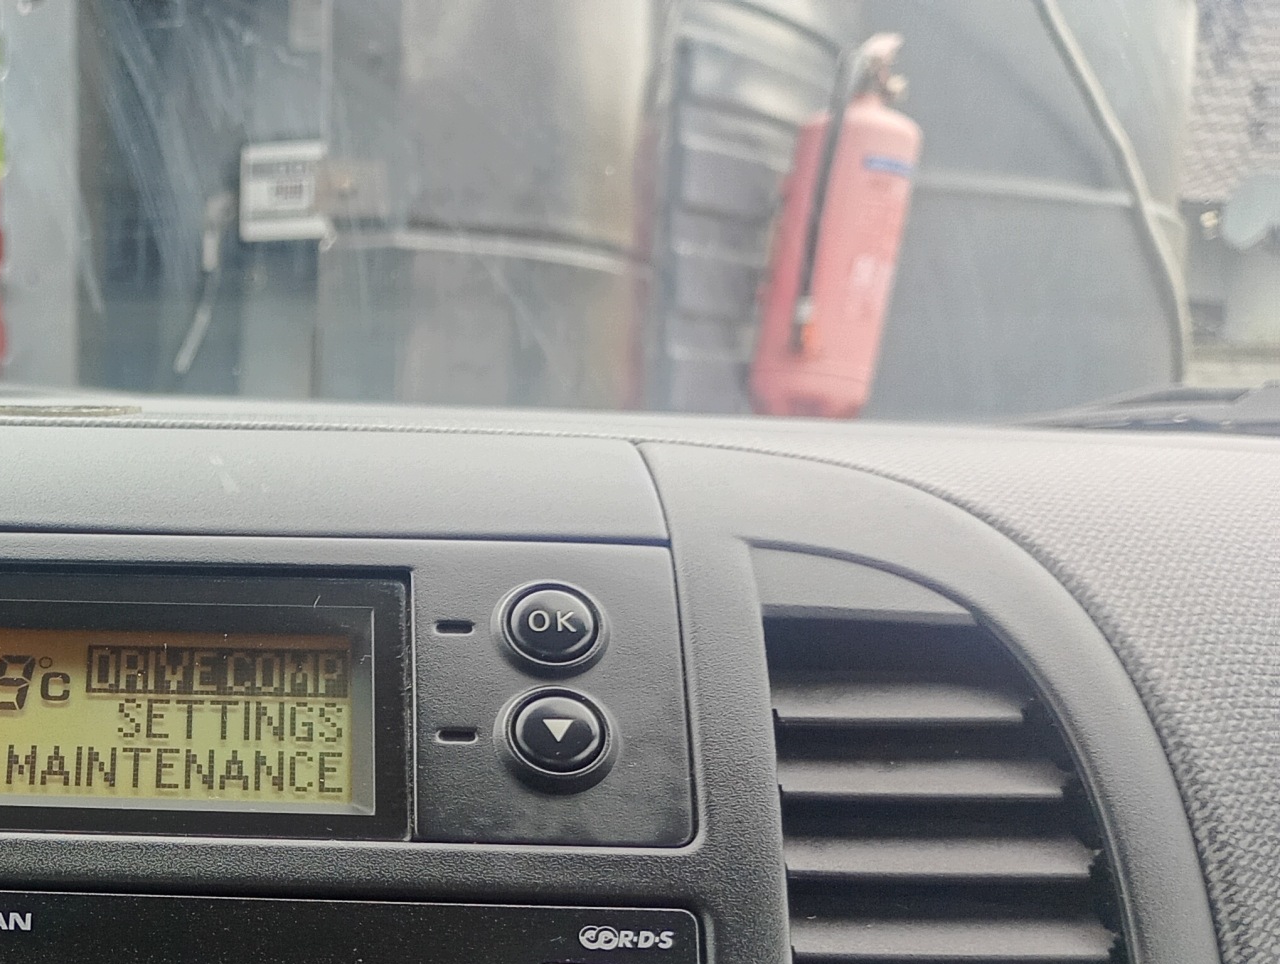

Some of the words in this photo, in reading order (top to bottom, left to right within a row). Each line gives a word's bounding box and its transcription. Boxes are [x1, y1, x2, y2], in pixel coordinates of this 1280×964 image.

[527, 610, 577, 633] OK
[117, 698, 344, 742] SETTINGS
[6, 744, 343, 793] MAINTENANCE
